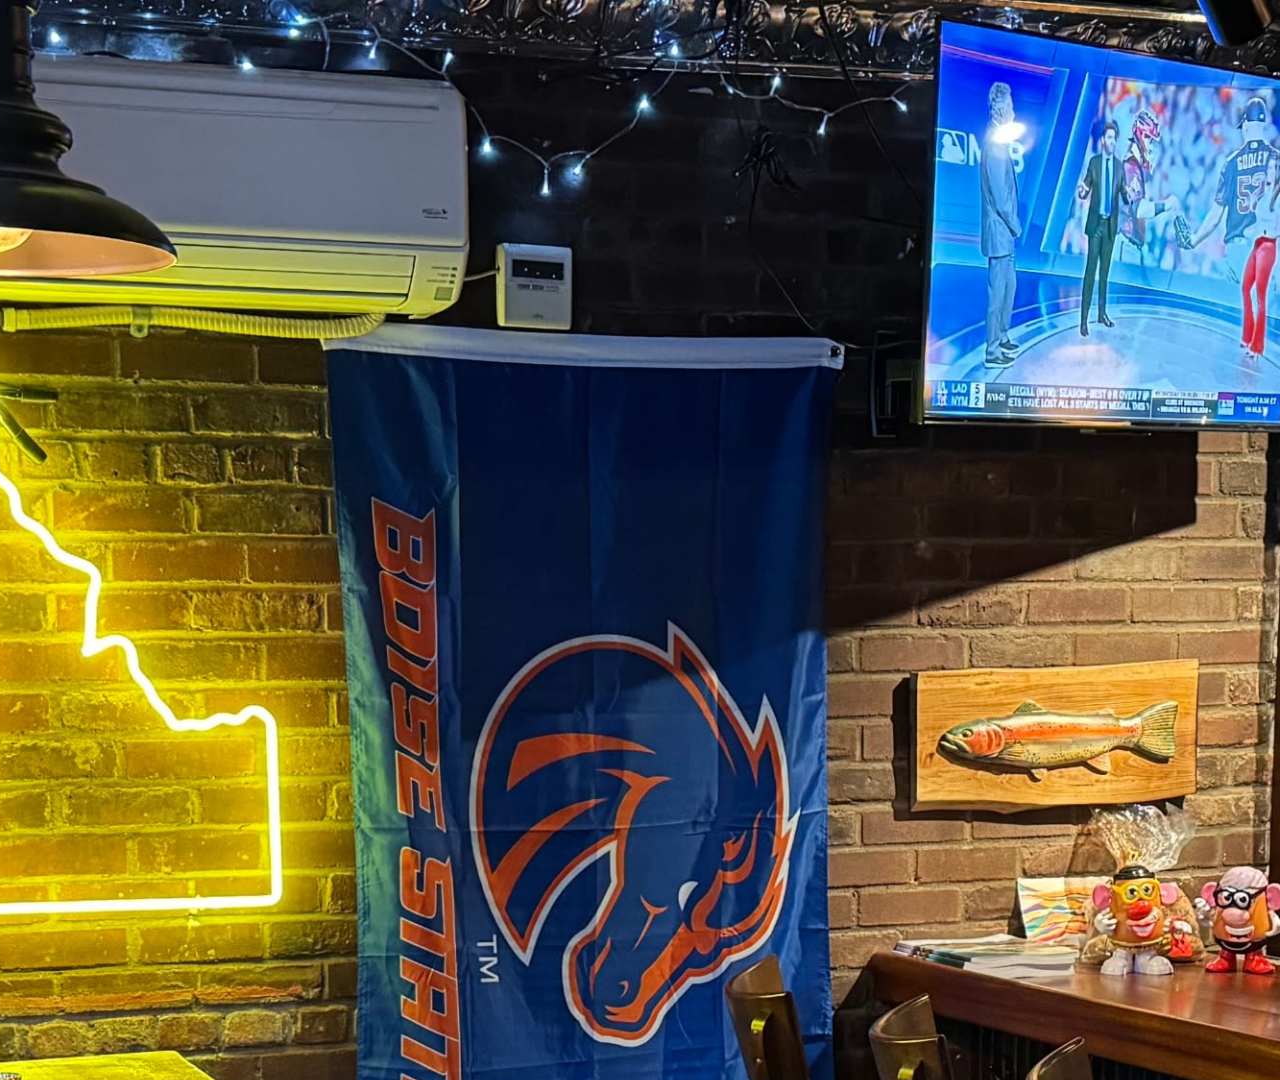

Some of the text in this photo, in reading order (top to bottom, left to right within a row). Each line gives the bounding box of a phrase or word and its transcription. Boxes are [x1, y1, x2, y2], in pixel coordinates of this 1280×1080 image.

[951, 384, 981, 394] LAD 5
[951, 396, 968, 408] NYM
[974, 396, 981, 407] 2
[371, 496, 448, 833] BOISE
[478, 932, 501, 985] TM
